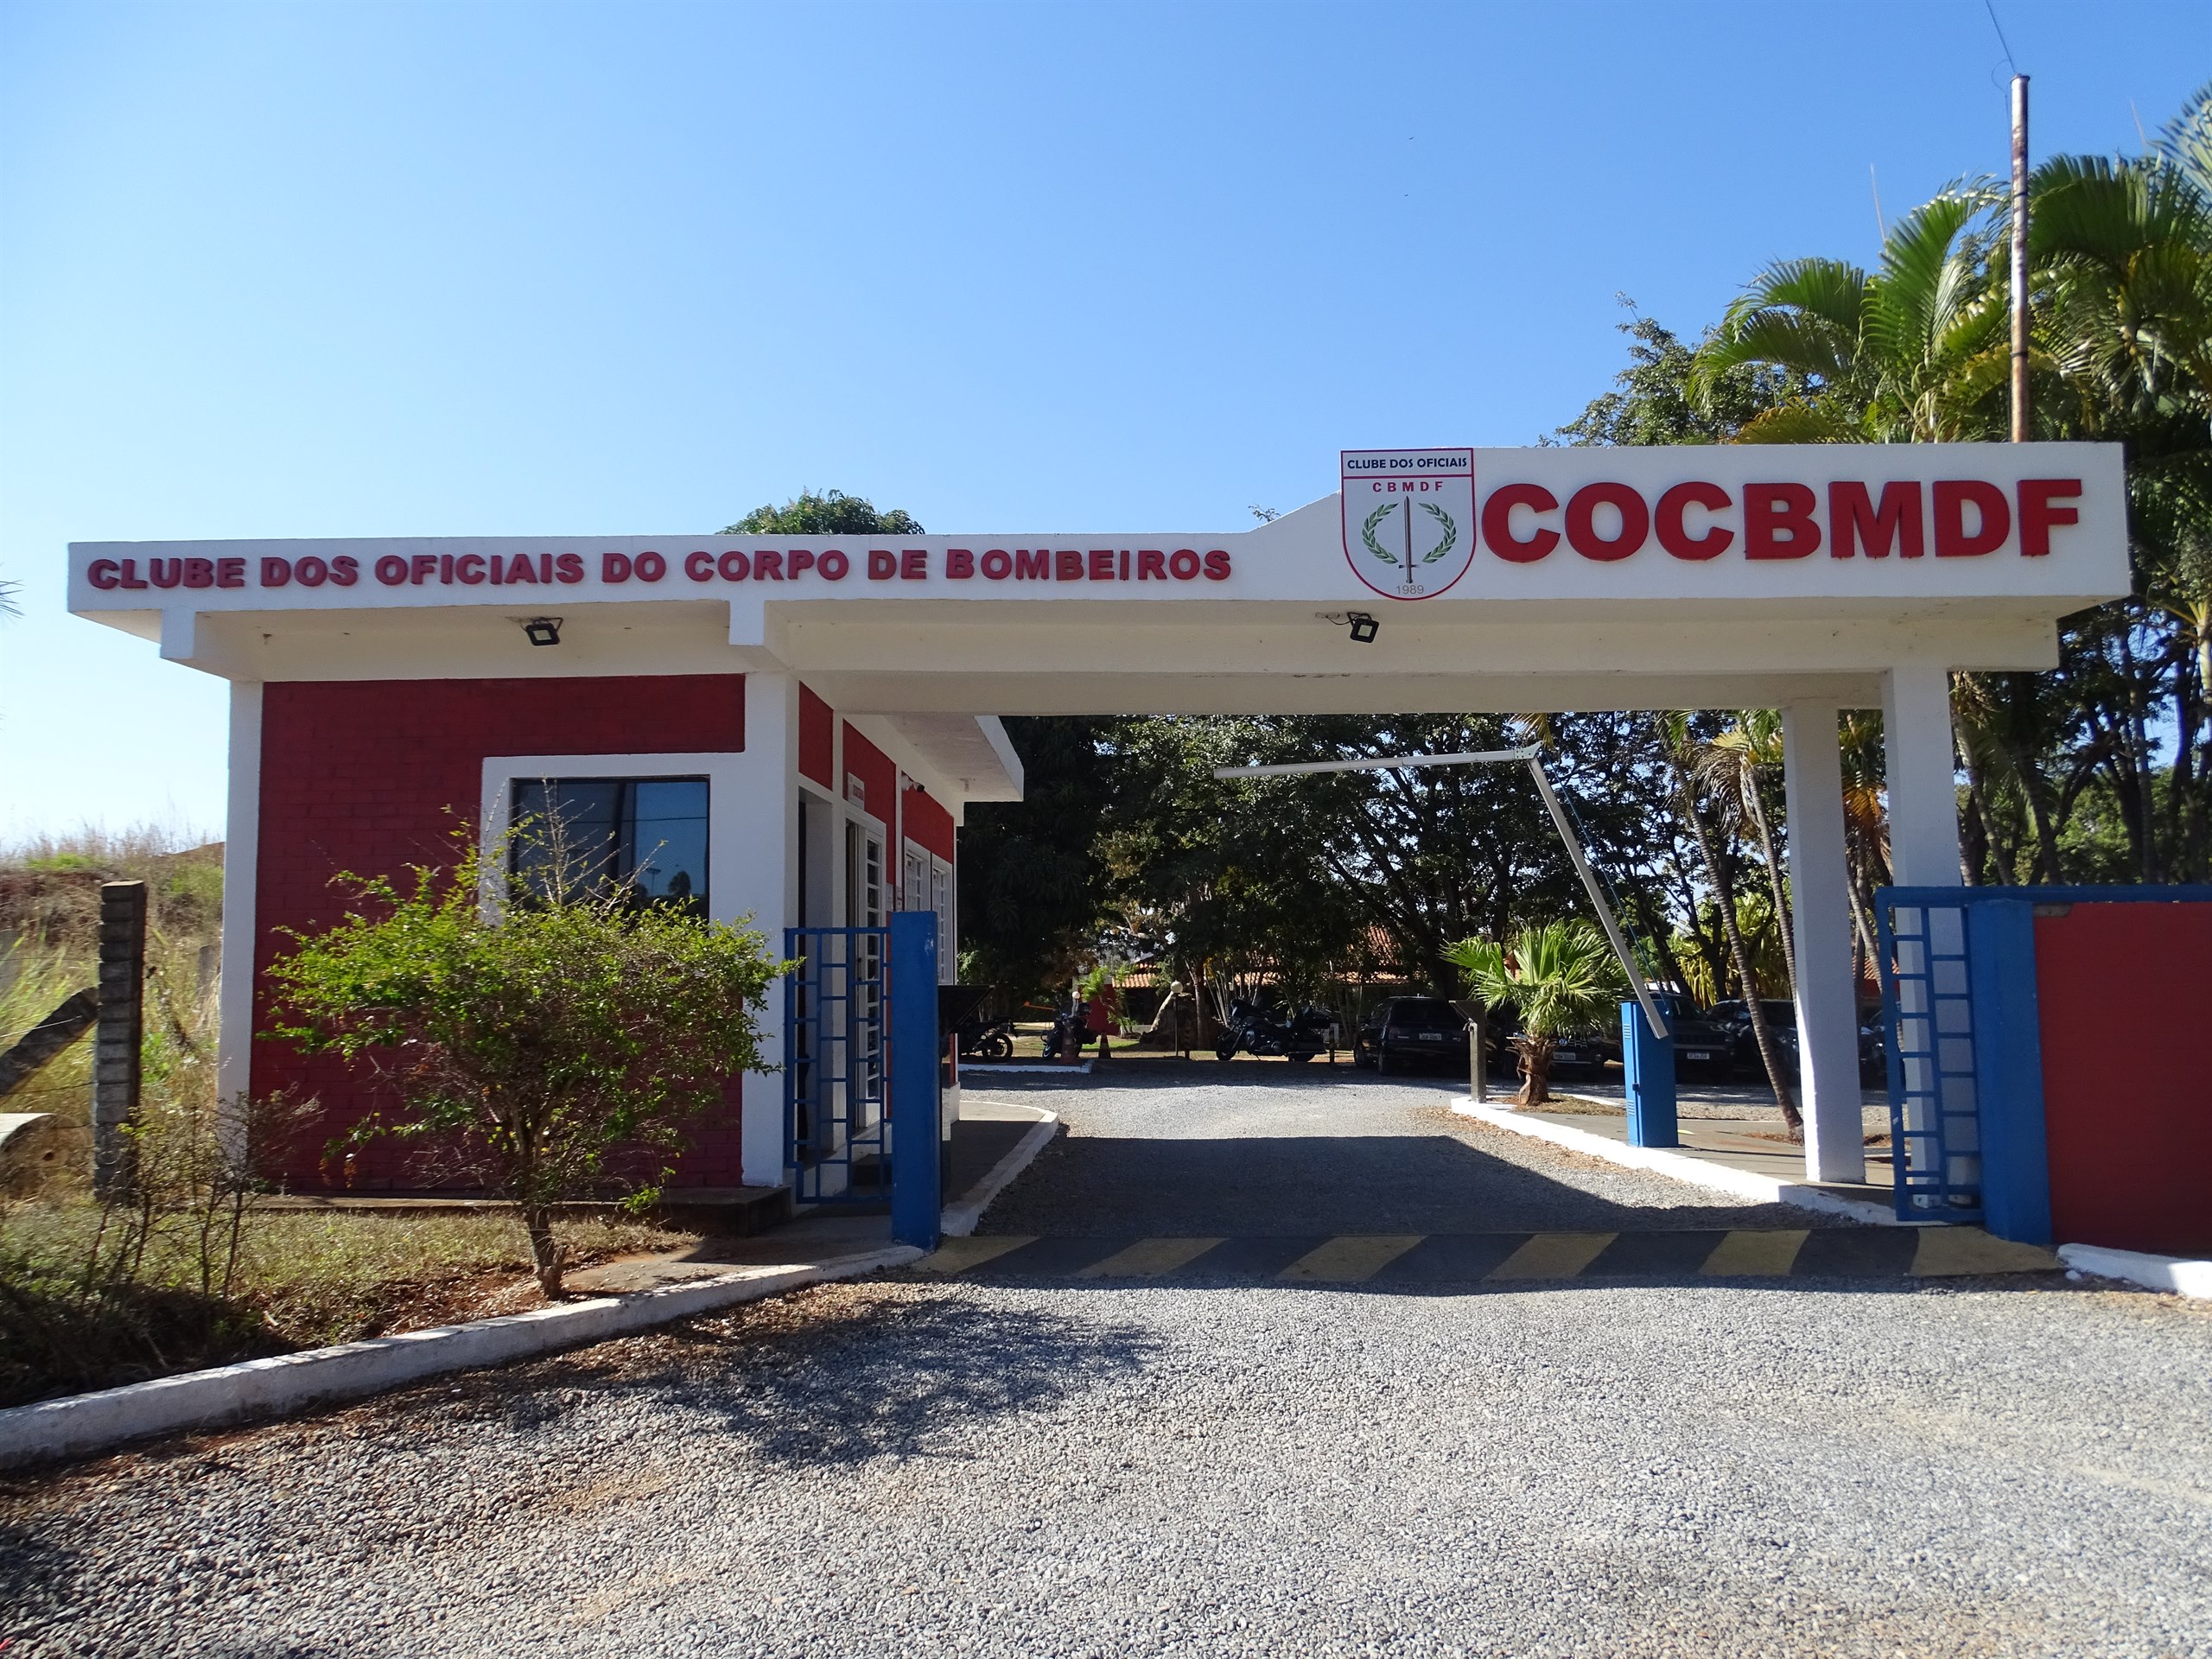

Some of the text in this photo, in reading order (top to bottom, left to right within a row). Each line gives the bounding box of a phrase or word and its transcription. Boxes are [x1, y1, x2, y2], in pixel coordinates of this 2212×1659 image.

[1347, 457, 1467, 469] CLUBE DOS OFICIAIS
[1481, 479, 2082, 564] COCBMDF
[87, 548, 1232, 590] CLUBE DOS OFICIAIS DO CORPO DE BOMBEIROS
[1395, 584, 1425, 595] 1989
